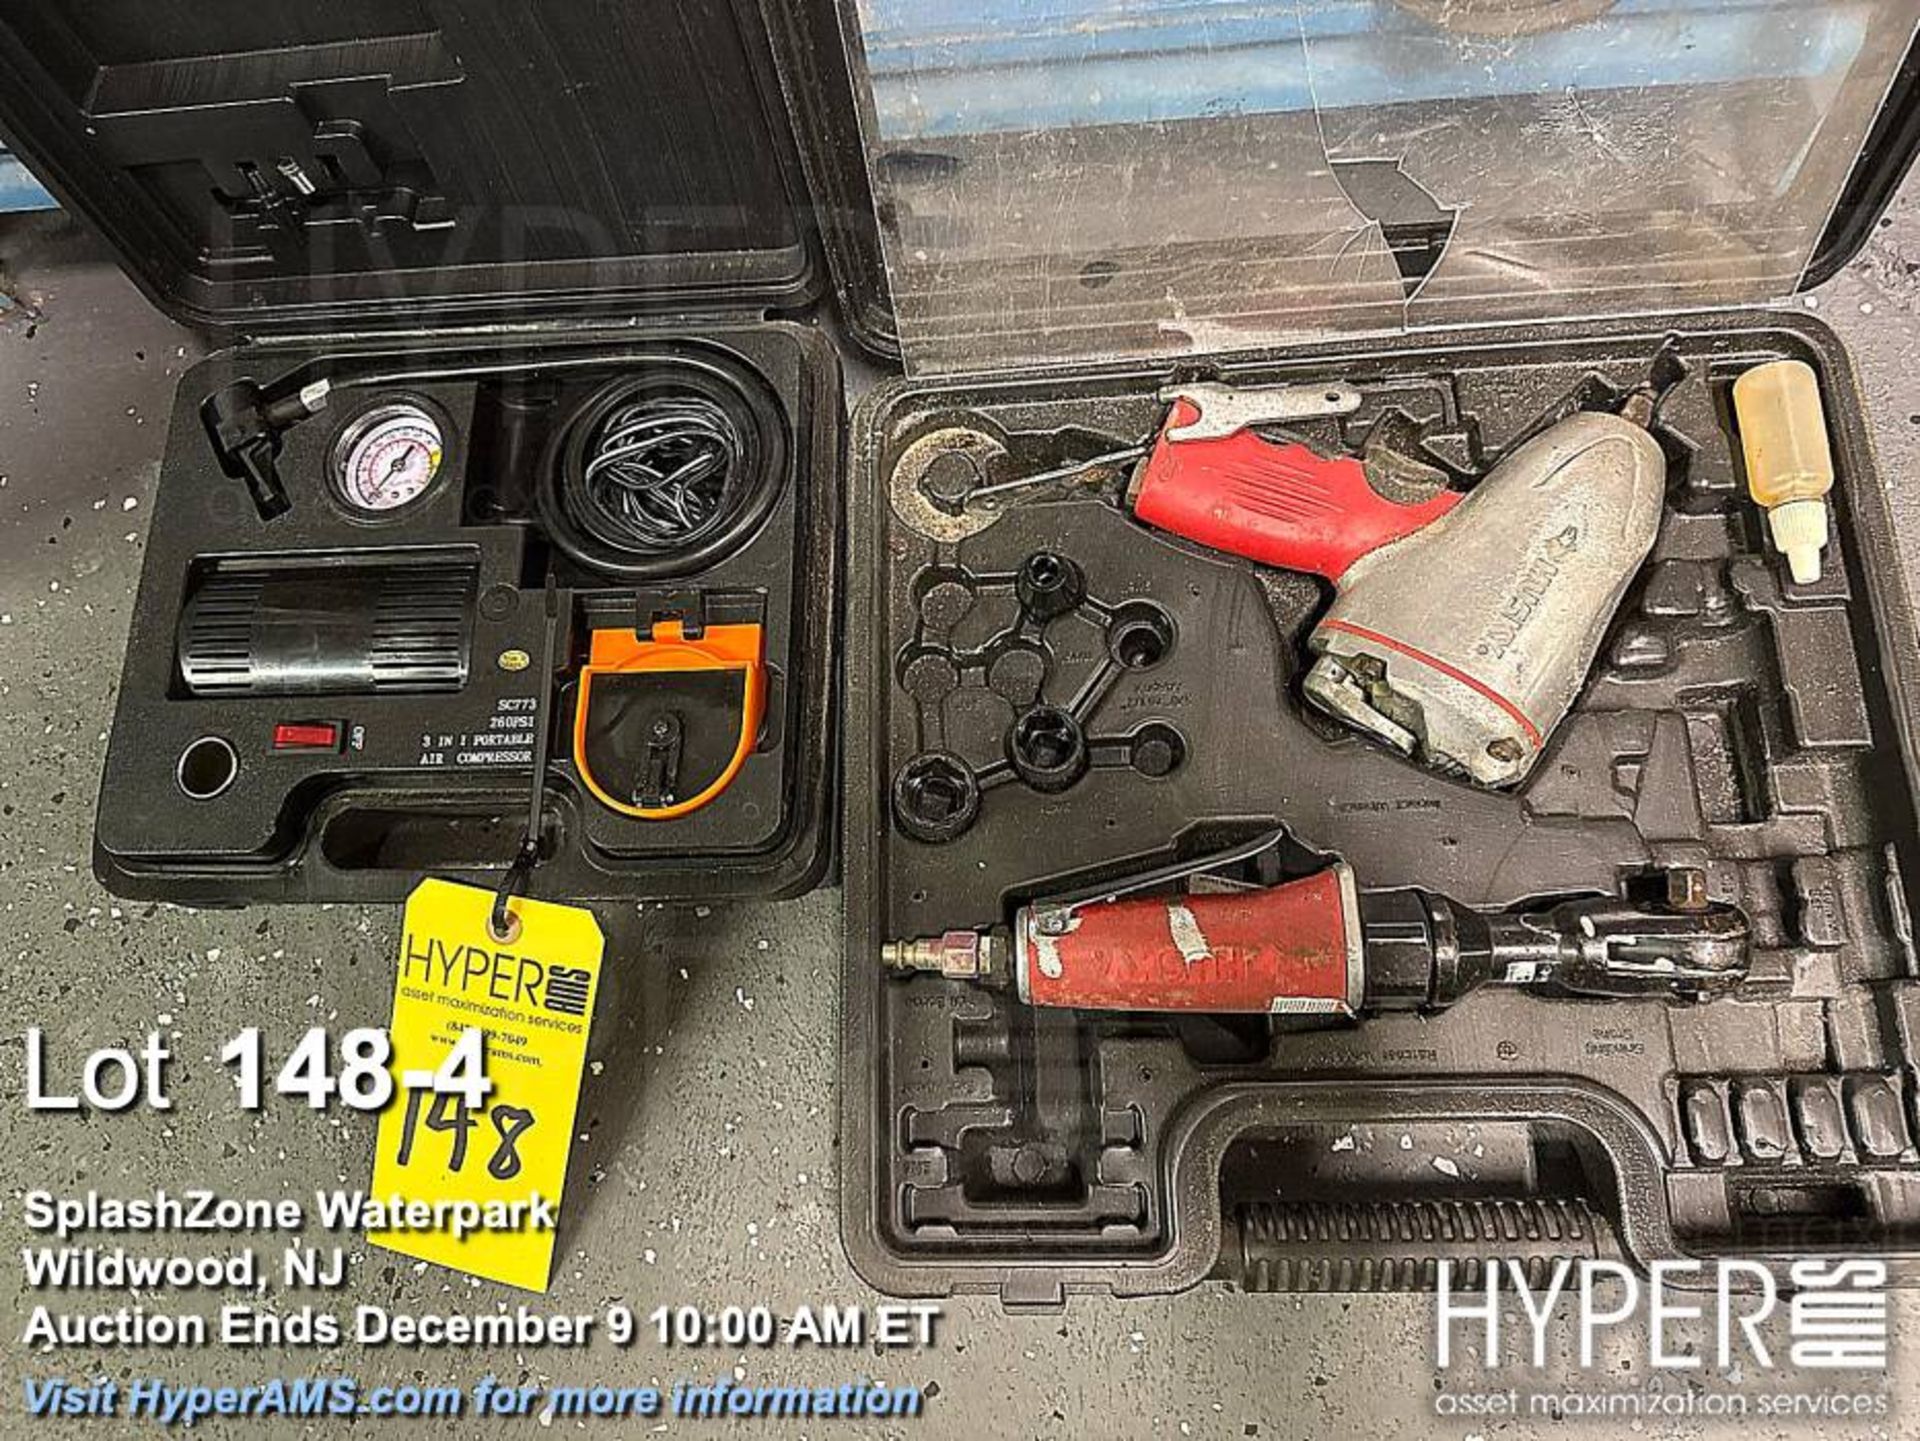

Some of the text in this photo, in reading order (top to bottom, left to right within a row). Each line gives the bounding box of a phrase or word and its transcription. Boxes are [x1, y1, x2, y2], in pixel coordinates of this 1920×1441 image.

[497, 698, 537, 711] SC773
[489, 716, 534, 729] 260PSI
[422, 735, 431, 748] 3
[438, 735, 453, 747] IN
[473, 733, 534, 746] PORTABLE
[420, 751, 532, 765] AIR COMPRESSOR
[404, 933, 544, 1007] HYPER
[401, 985, 583, 1035] asset maximization services
[397, 1088, 535, 1180] 148
